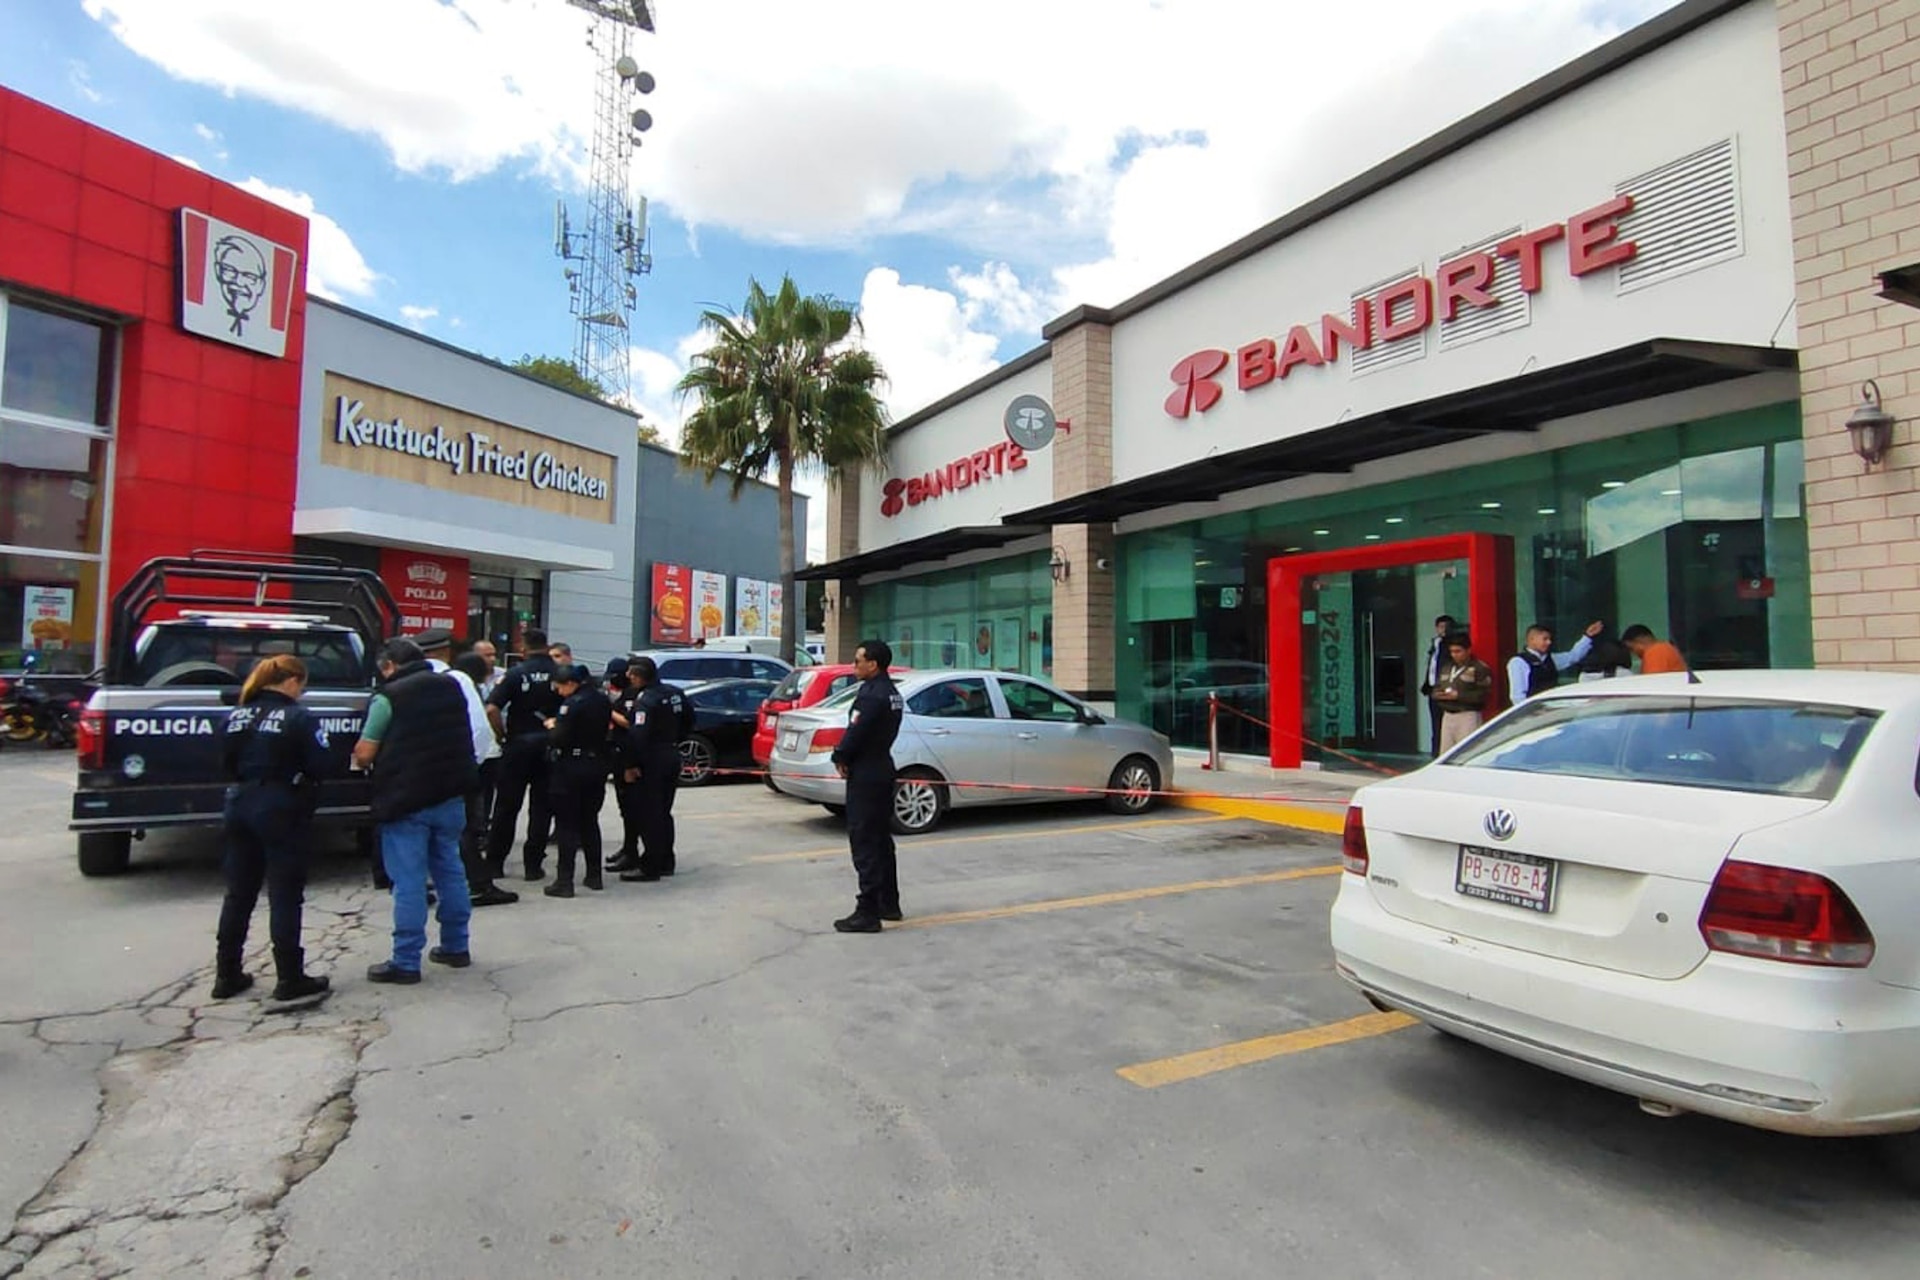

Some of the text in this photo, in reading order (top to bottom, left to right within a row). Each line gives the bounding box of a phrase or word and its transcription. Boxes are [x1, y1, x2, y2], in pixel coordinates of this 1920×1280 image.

[1237, 195, 1638, 391] BANORTE
[336, 396, 607, 500] Kentucky Fried Chicken
[907, 442, 1028, 506] BANORTE
[405, 587, 447, 600] POLLO
[115, 716, 213, 735] POLICÍA
[229, 707, 285, 721] POLIA
